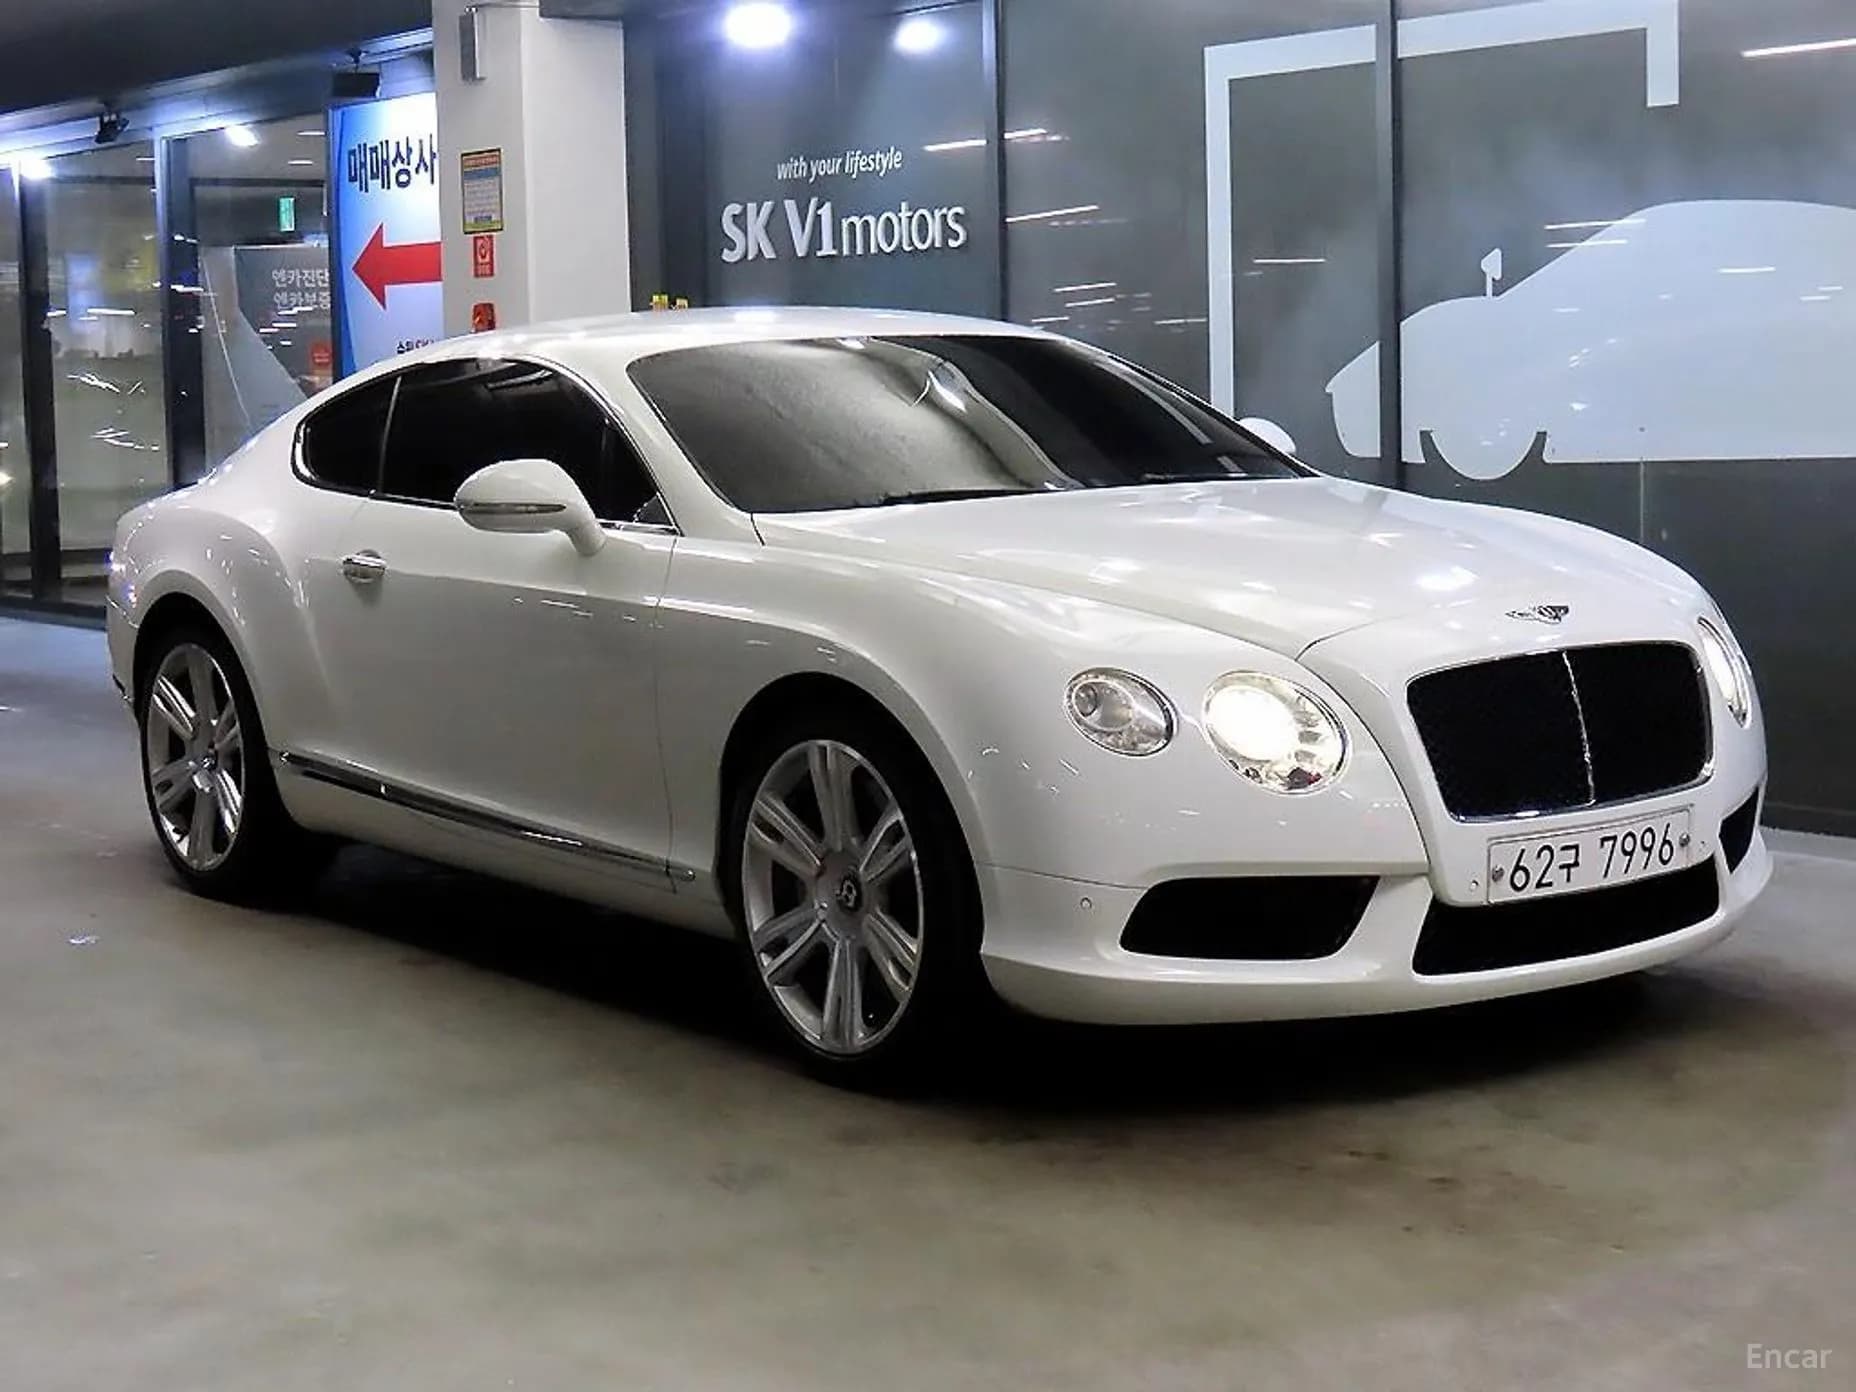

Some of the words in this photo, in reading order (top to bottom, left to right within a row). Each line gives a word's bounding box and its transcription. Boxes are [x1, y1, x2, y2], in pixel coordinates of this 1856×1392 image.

[347, 133, 437, 193] 매매상사
[777, 157, 807, 180] with
[809, 156, 841, 183] your
[845, 147, 903, 178] lifestyle
[721, 201, 776, 262] SK
[1509, 843, 1580, 892] 62구
[1600, 822, 1674, 878] 7996
